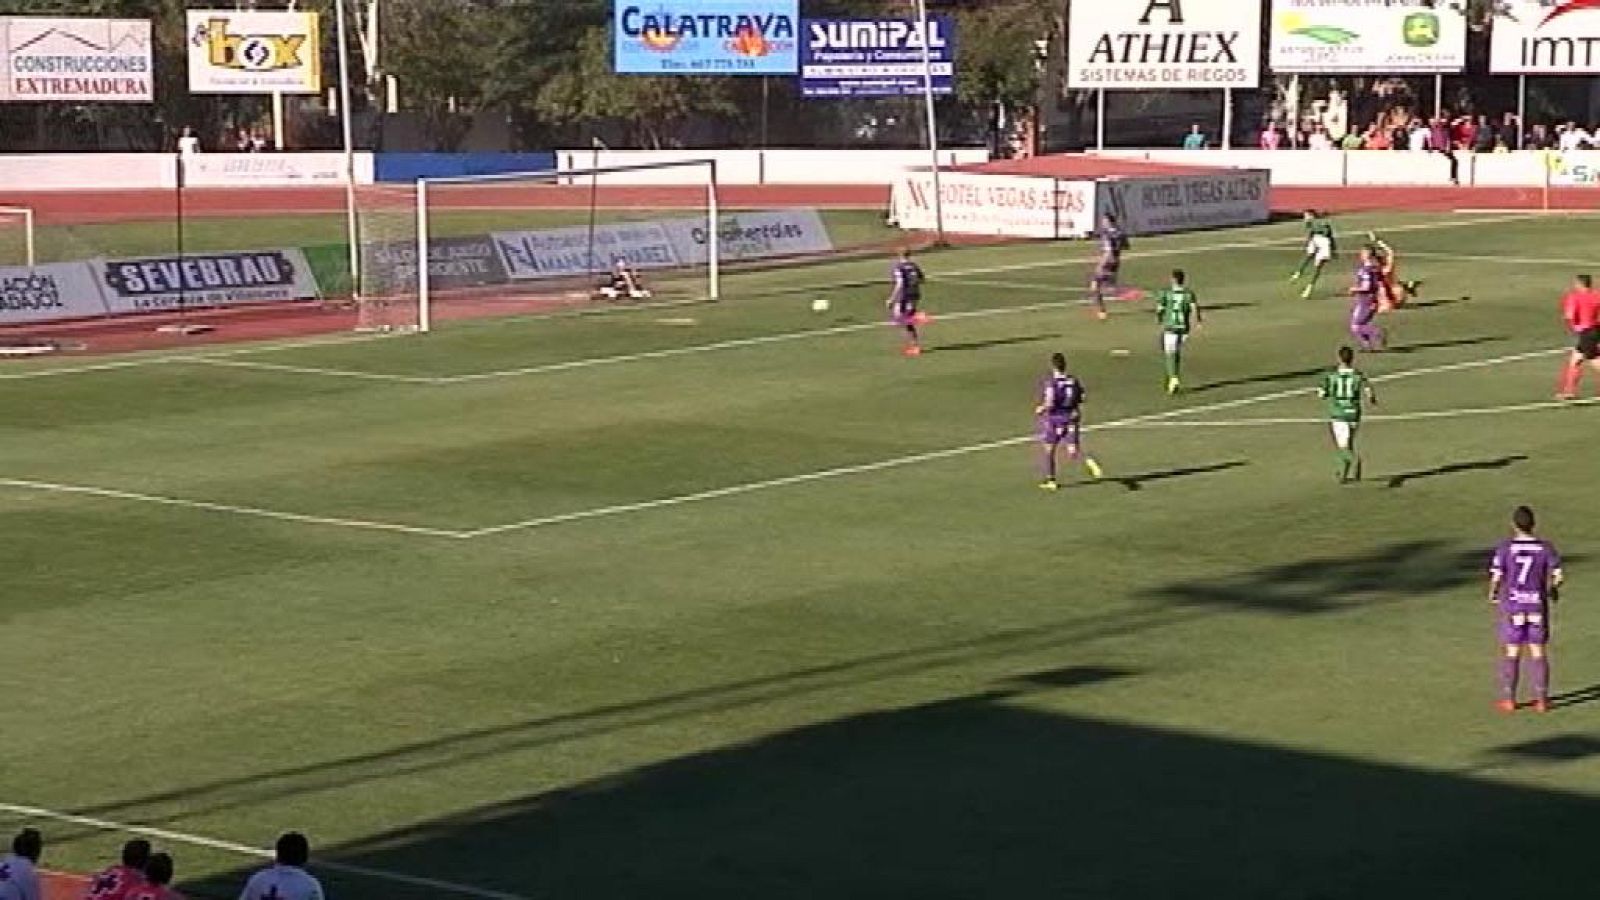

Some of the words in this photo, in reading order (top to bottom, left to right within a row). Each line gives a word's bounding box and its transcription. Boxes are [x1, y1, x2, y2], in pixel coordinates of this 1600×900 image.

[1087, 31, 1240, 64] ATHIEX
[14, 55, 148, 72] CONSTRUCCIONES
[1079, 68, 1157, 82] SISTEMAS
[1161, 68, 1183, 82] DE
[1186, 68, 1248, 82] RIEGOS
[15, 77, 148, 94] EXTREMADURA
[988, 186, 1037, 210] VEGAS
[120, 255, 282, 293] SEVEBRAU
[1515, 555, 1533, 585] 7
